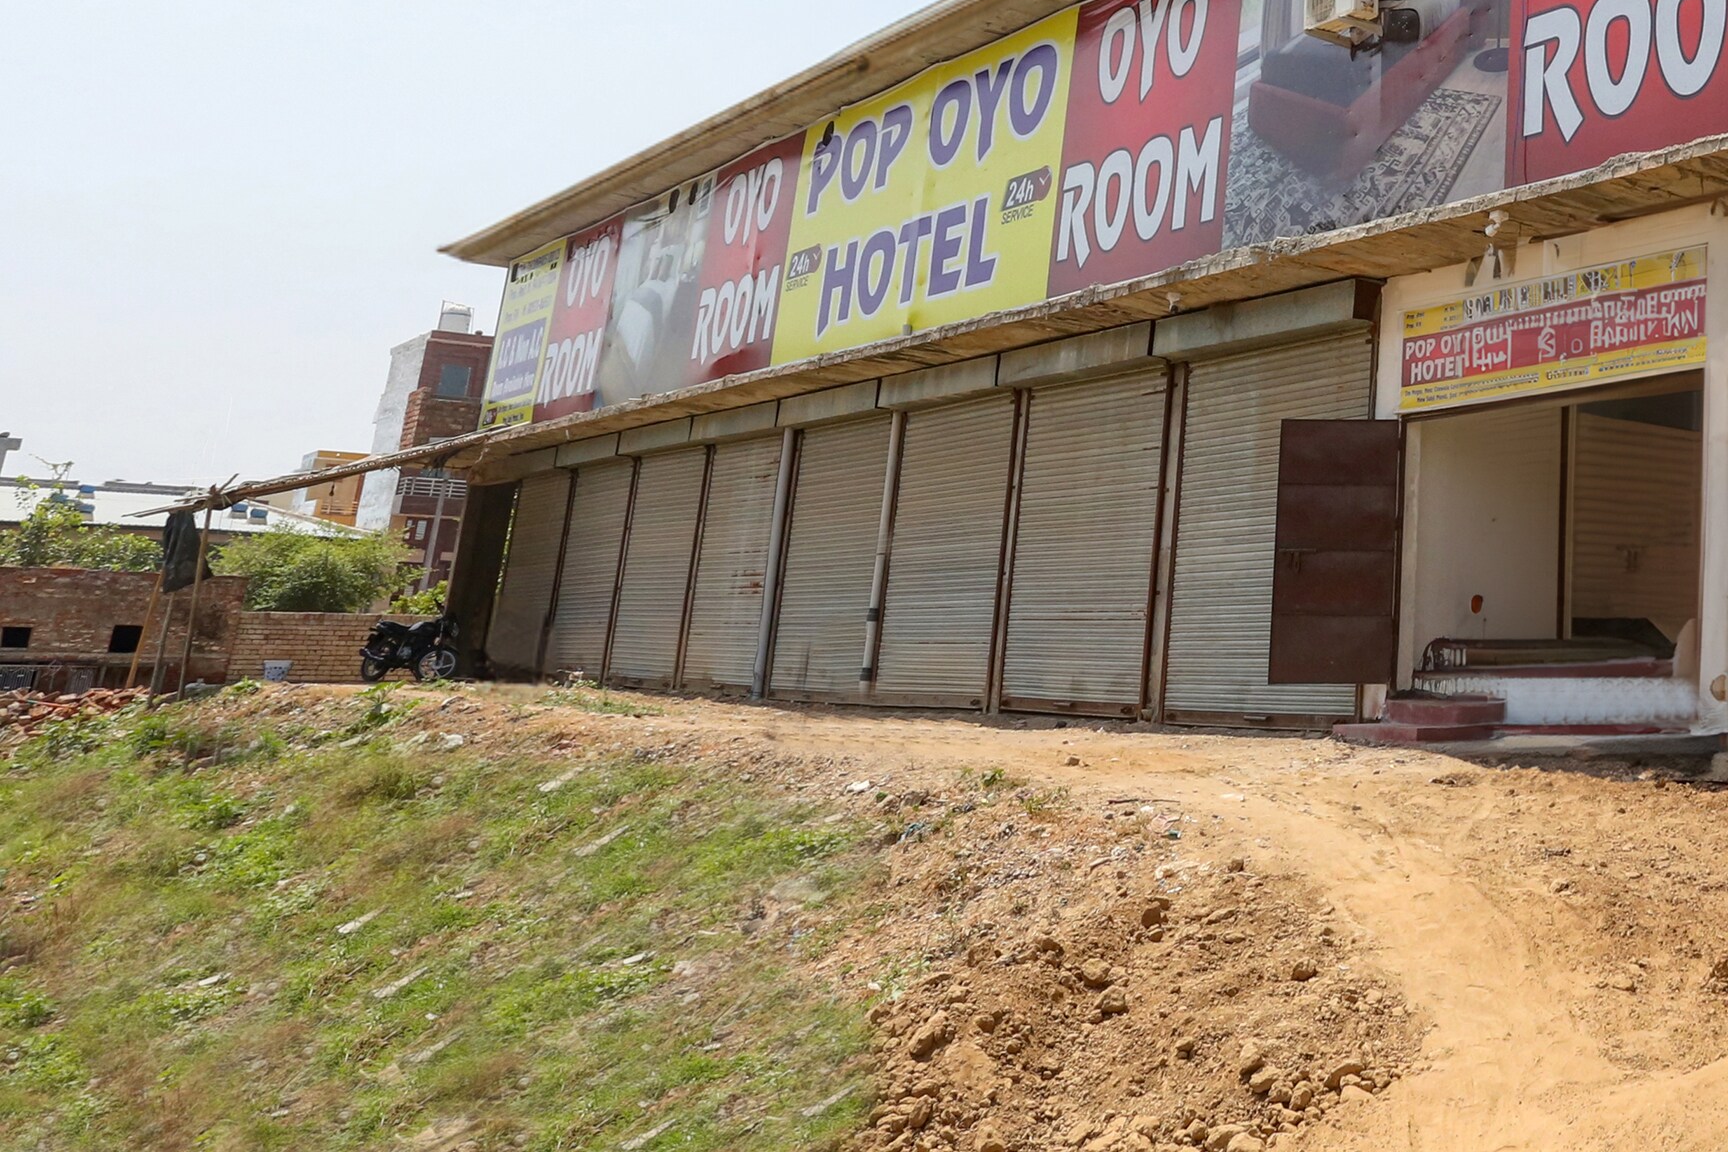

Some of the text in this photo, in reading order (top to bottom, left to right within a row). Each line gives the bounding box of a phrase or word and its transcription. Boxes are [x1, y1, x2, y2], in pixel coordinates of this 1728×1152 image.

[805, 40, 1059, 217] POP OYO
[723, 157, 783, 246] OYO
[1000, 204, 1034, 226] SERVICE
[1006, 176, 1036, 206] 24h
[1056, 116, 1224, 269] ROOM
[566, 235, 611, 309] OYO
[784, 274, 809, 293] SERVICE
[788, 253, 811, 279] 24h
[815, 195, 998, 341] HOTEL
[690, 264, 781, 365] ROOM
[1405, 337, 1436, 361] POP
[538, 327, 602, 408] ROOM
